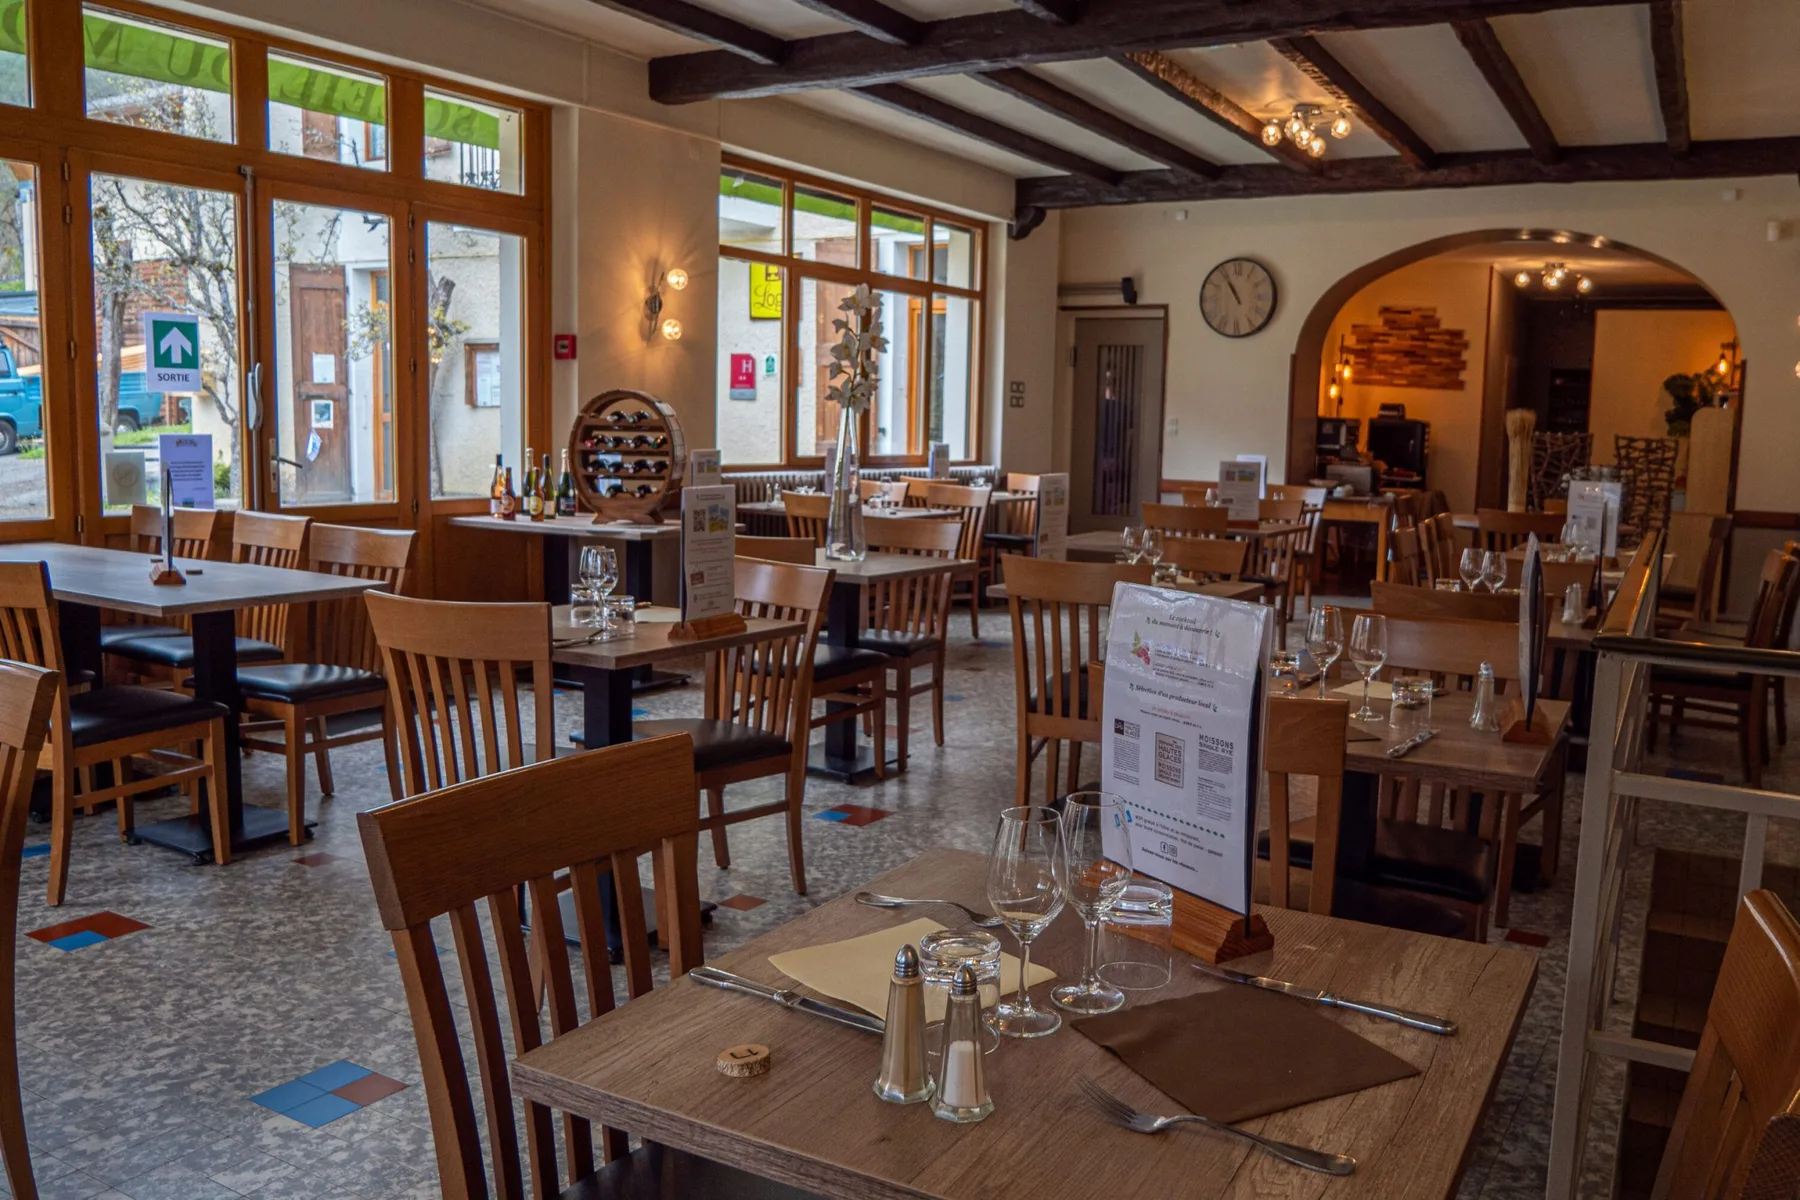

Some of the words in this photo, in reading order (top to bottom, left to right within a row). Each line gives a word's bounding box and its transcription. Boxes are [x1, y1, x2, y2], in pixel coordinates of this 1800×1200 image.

[742, 359, 752, 373] H
[157, 372, 190, 382] SORTIE
[1135, 684, 1157, 695] Sélection
[1169, 694, 1197, 706] producteur
[1198, 700, 1211, 708] local
[1199, 733, 1233, 750] MOISSONS
[1158, 746, 1182, 757] HAUTES
[1158, 751, 1182, 764] GLACES
